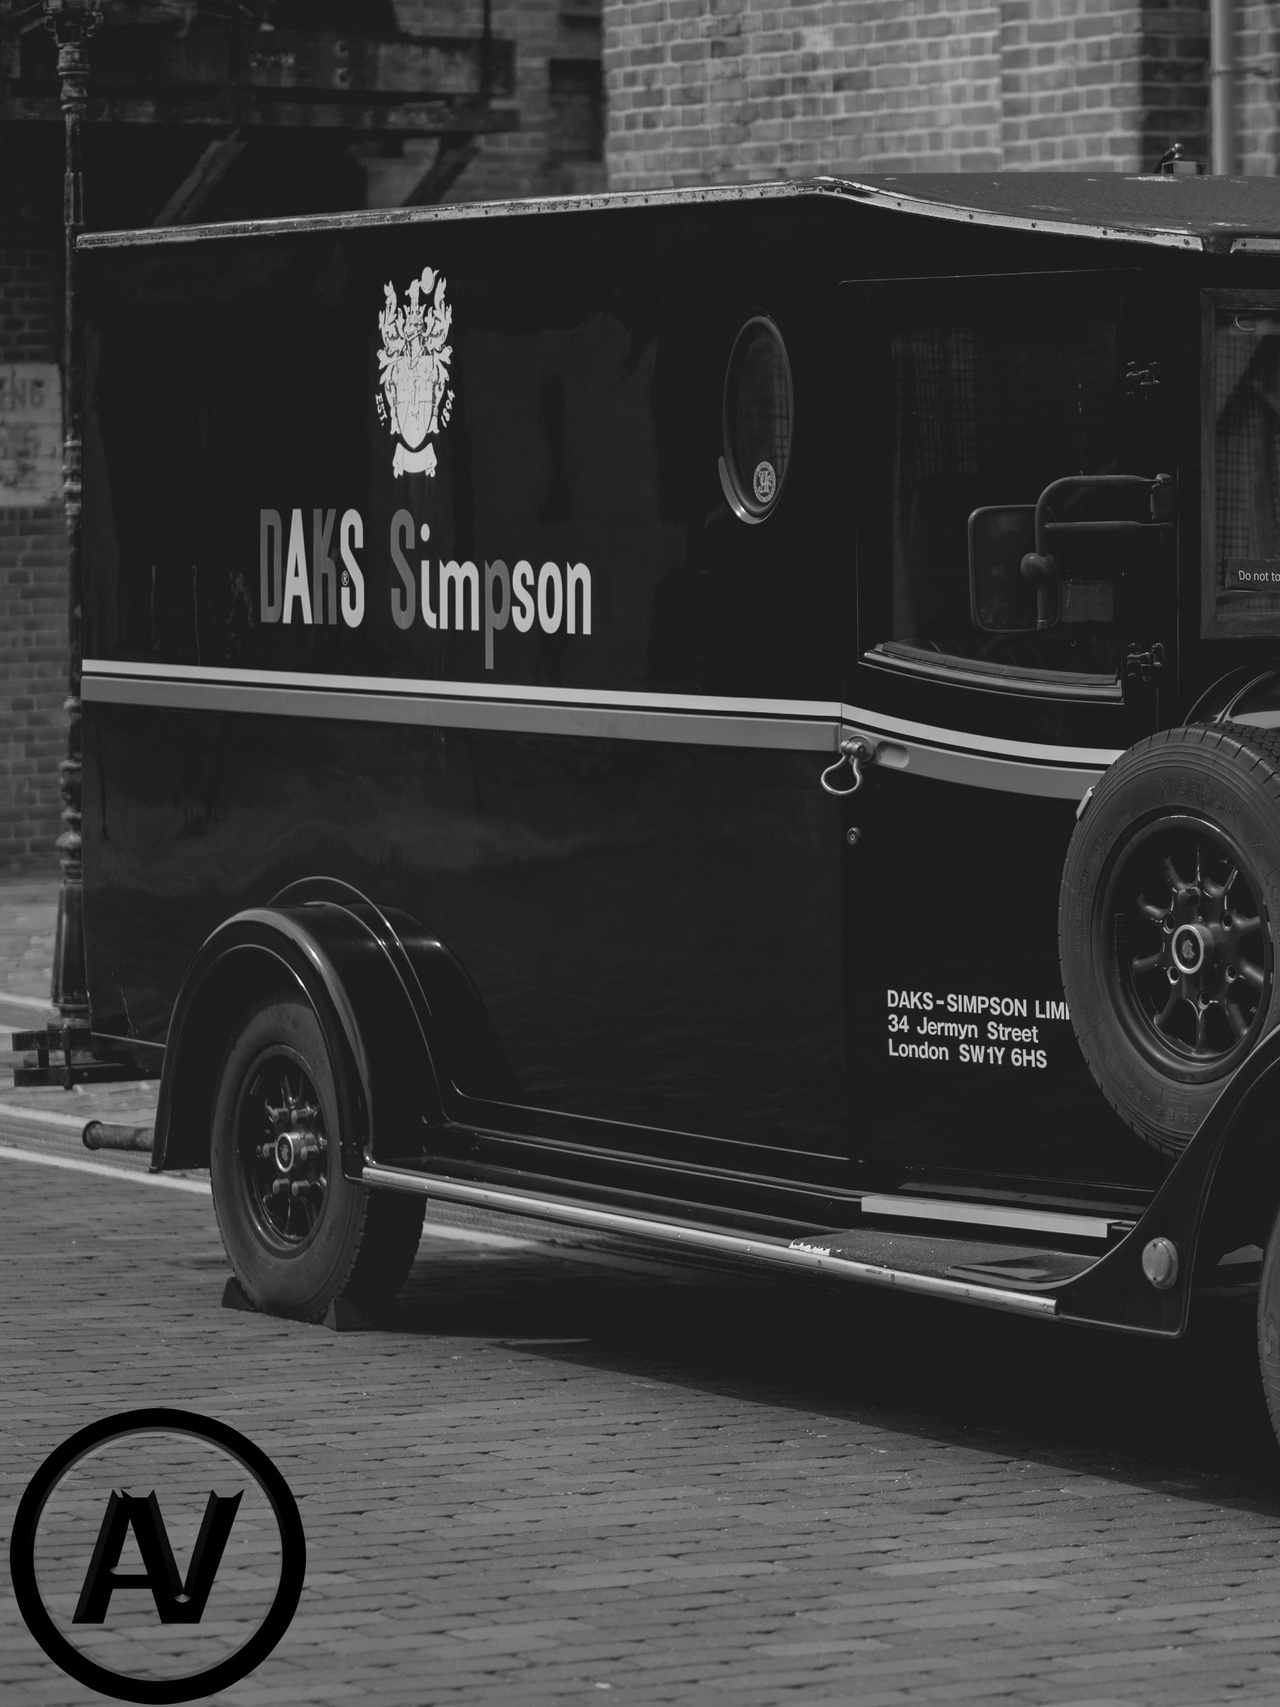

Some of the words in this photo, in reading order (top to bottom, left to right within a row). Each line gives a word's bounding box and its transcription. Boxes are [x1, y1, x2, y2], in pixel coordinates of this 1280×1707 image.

[375, 393, 388, 427] EST.
[440, 389, 456, 429] 1894
[260, 508, 365, 628] DAKS
[390, 508, 592, 670] Simpson
[1238, 570, 1252, 581] Do
[1253, 571, 1269, 582] not
[1158, 776, 1240, 823] MICHELIN
[887, 1014, 909, 1033] 34
[916, 1016, 979, 1040] Jermyn
[987, 1021, 1039, 1043] Street
[888, 1038, 950, 1061] London
[1010, 1048, 1048, 1069] 6HS
